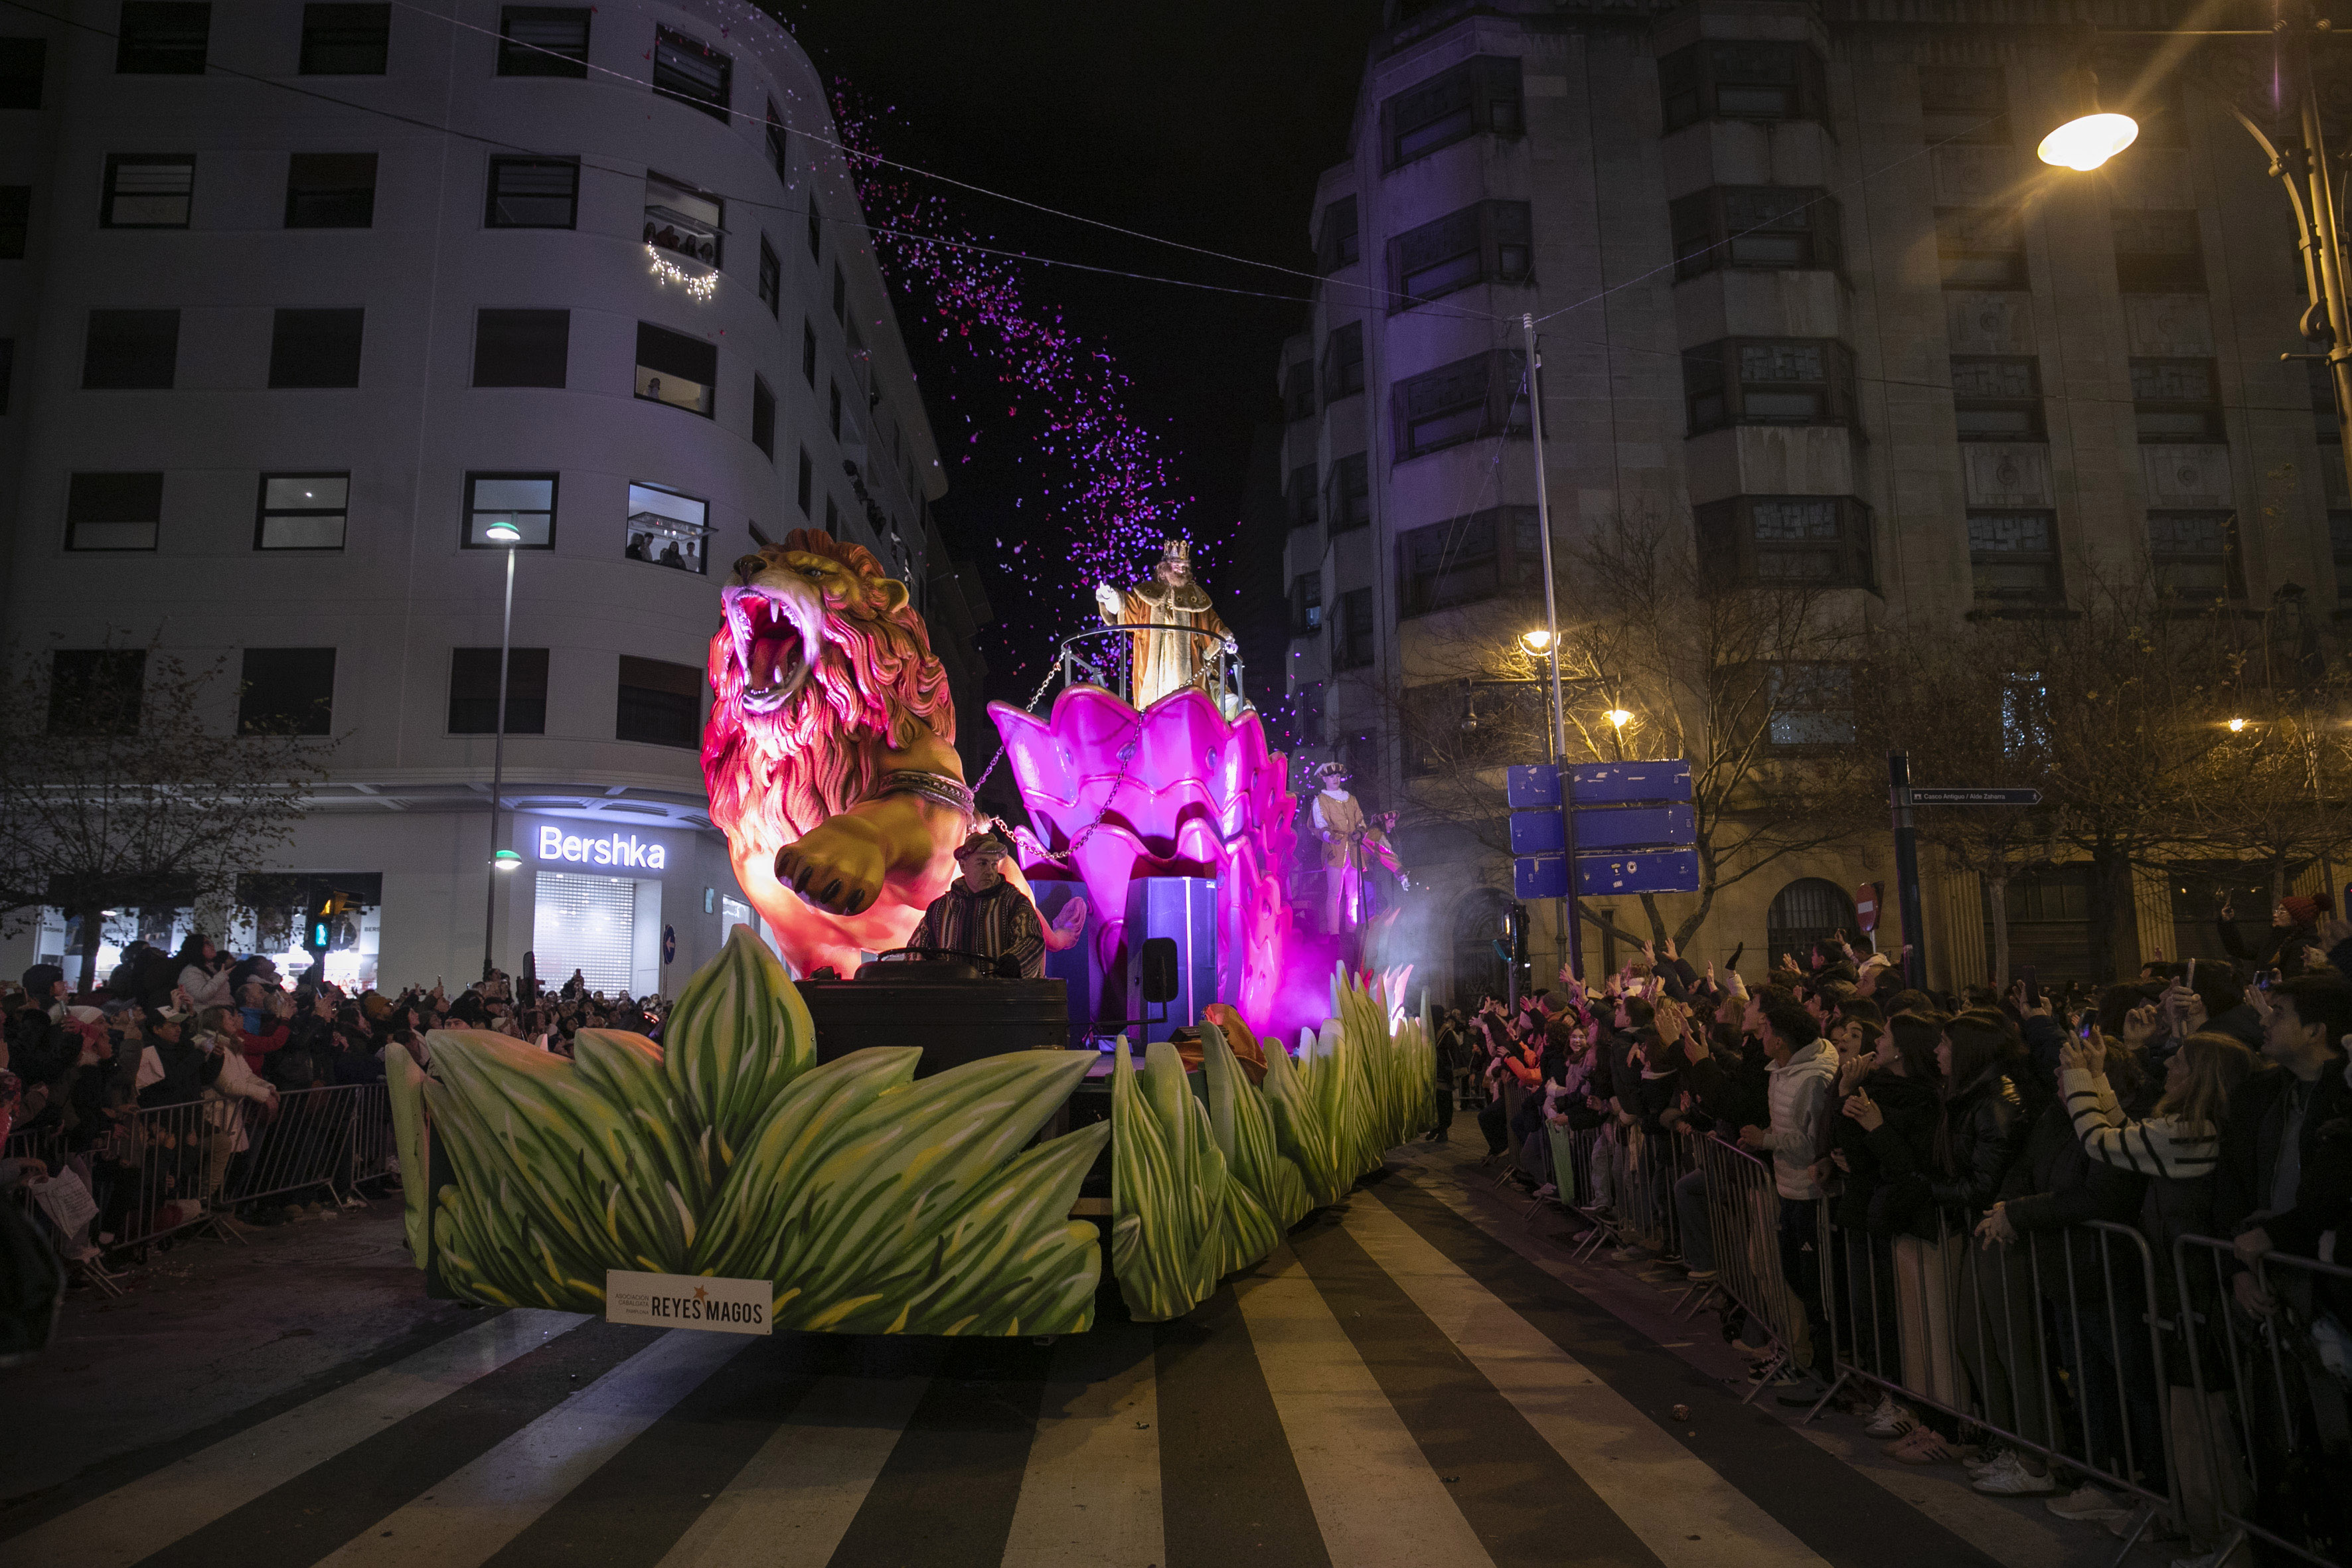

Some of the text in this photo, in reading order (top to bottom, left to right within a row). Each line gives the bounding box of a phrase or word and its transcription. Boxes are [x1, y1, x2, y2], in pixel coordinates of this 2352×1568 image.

[539, 825, 665, 870] Bershka
[652, 1296, 762, 1324] REYES MAGOS
